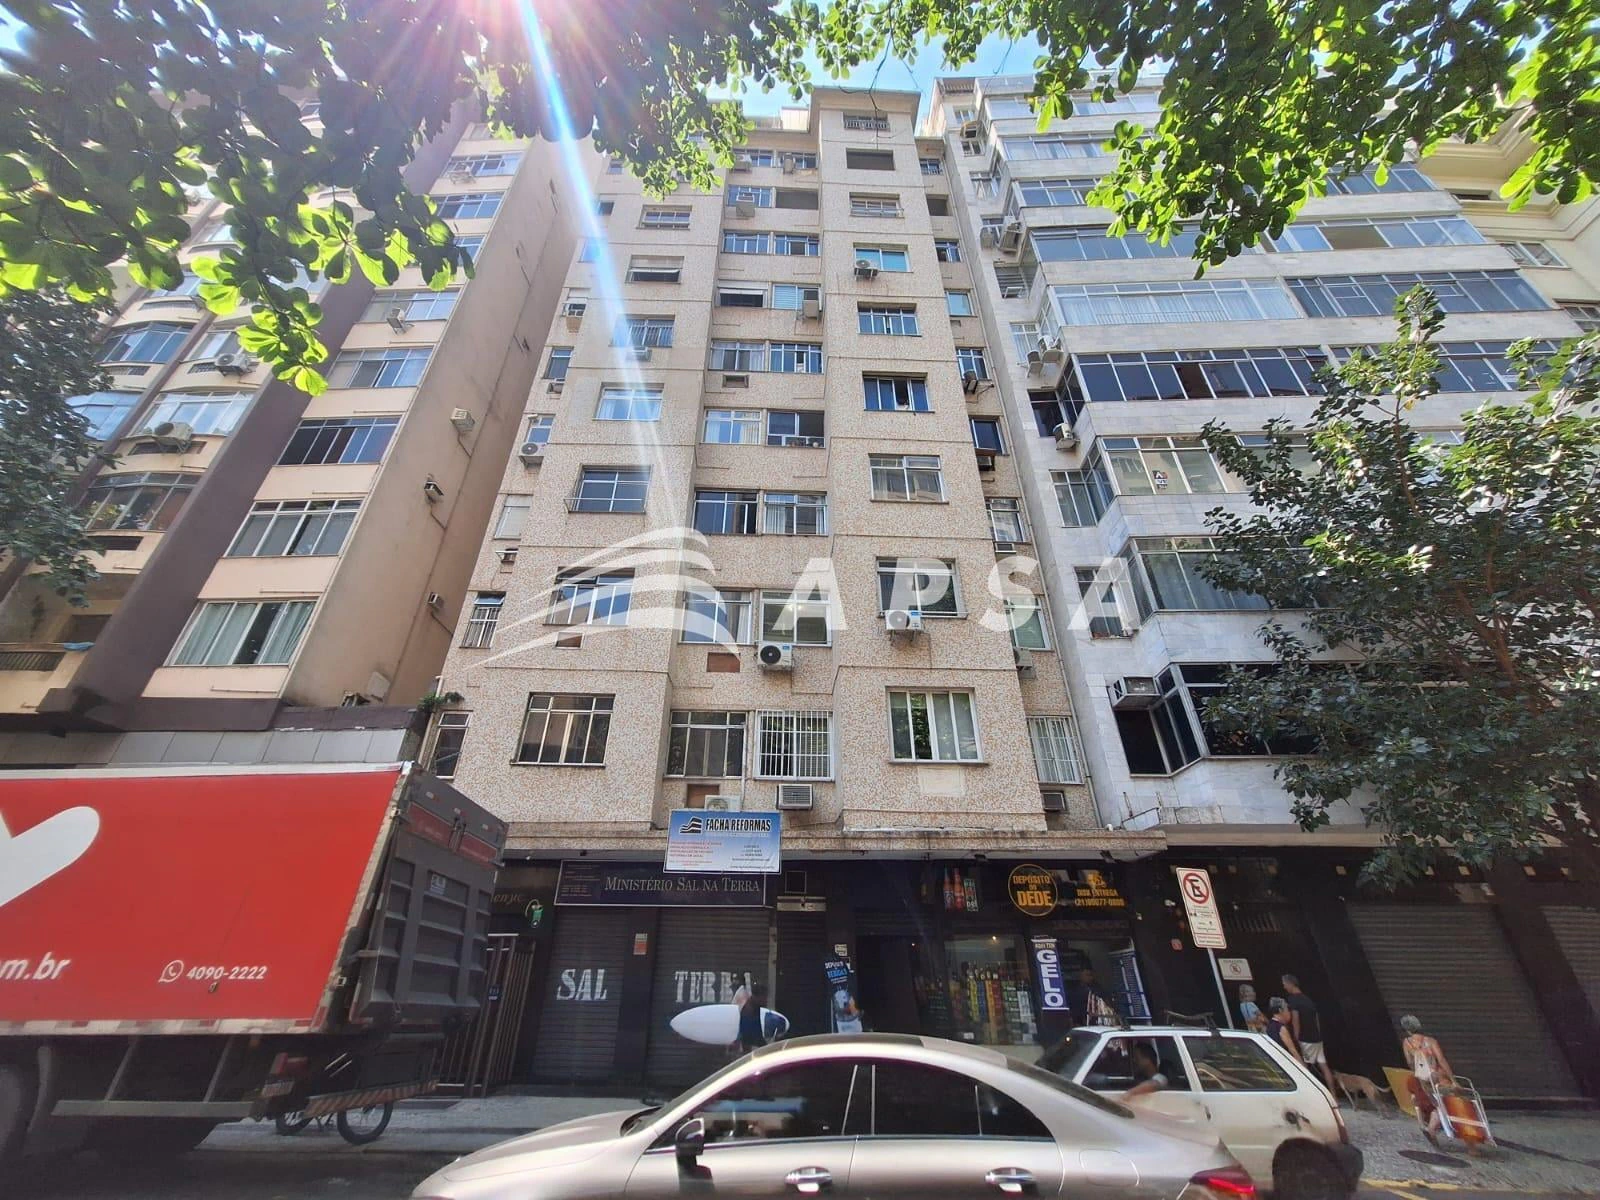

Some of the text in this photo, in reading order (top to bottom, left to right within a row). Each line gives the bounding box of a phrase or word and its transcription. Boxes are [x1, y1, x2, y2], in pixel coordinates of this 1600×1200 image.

[705, 818, 771, 832] FACHA REFORMAS
[604, 875, 673, 891] MINISTÉRIO
[676, 877, 699, 891] SAL
[702, 880, 719, 891] NA
[721, 877, 760, 892] TERRA
[186, 965, 268, 980] 4090-2222
[1036, 949, 1064, 1007] GELO
[556, 968, 607, 1001] SAL
